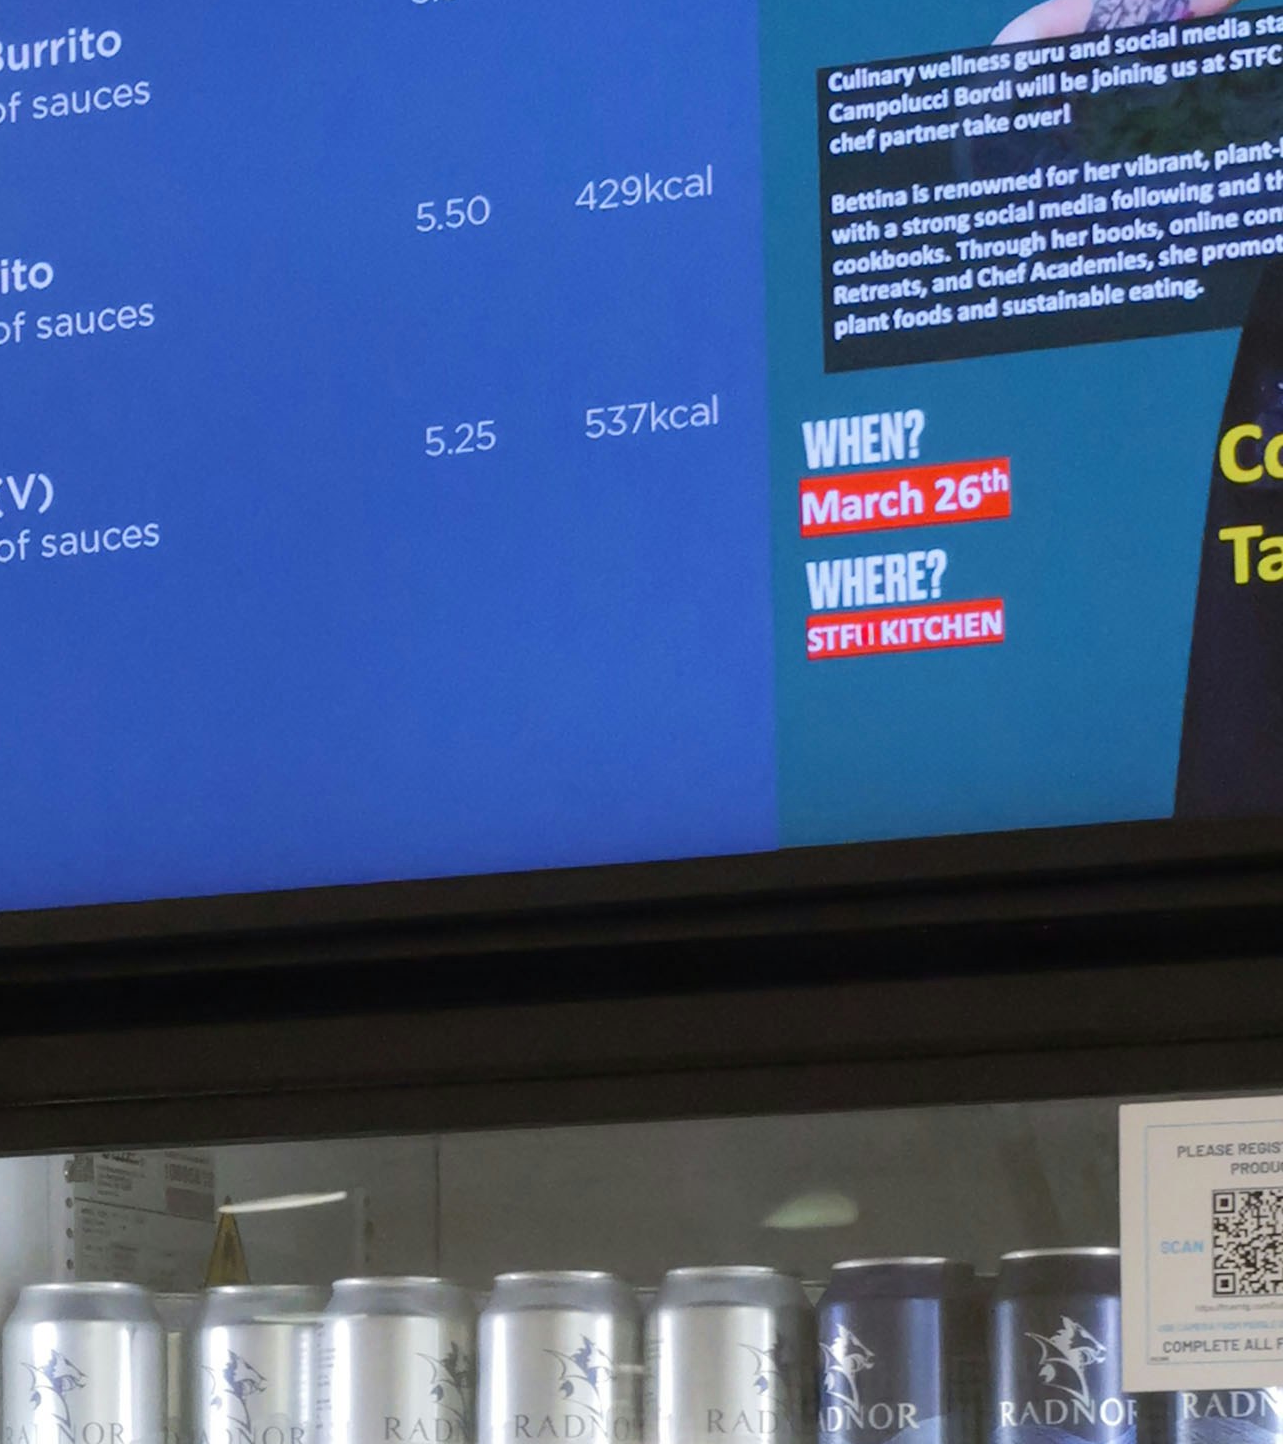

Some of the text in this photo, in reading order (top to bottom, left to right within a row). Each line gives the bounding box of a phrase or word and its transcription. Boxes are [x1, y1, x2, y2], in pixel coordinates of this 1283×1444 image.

[829, 22, 1250, 91] Culinary wellness guru and social media
[33, 81, 150, 119] sauces
[830, 45, 1281, 122] Campolucci Bordi will be joining us at STFC
[831, 129, 874, 153] chef
[881, 124, 958, 151] partner
[963, 114, 1008, 136] take
[417, 164, 712, 231] 5.50 429kcal
[37, 304, 154, 339] sauces
[426, 395, 718, 456] 5.25 537kcal
[803, 410, 924, 468] WHEN?
[802, 468, 1009, 525] March 26th
[42, 523, 159, 557] sauces
[807, 550, 946, 609] WHERE?
[881, 610, 1002, 645] KITCHEN
[1177, 1143, 1234, 1158] PLEASE
[1160, 1240, 1205, 1255] SCAN
[1163, 1337, 1272, 1353] COMPLETE ALL
